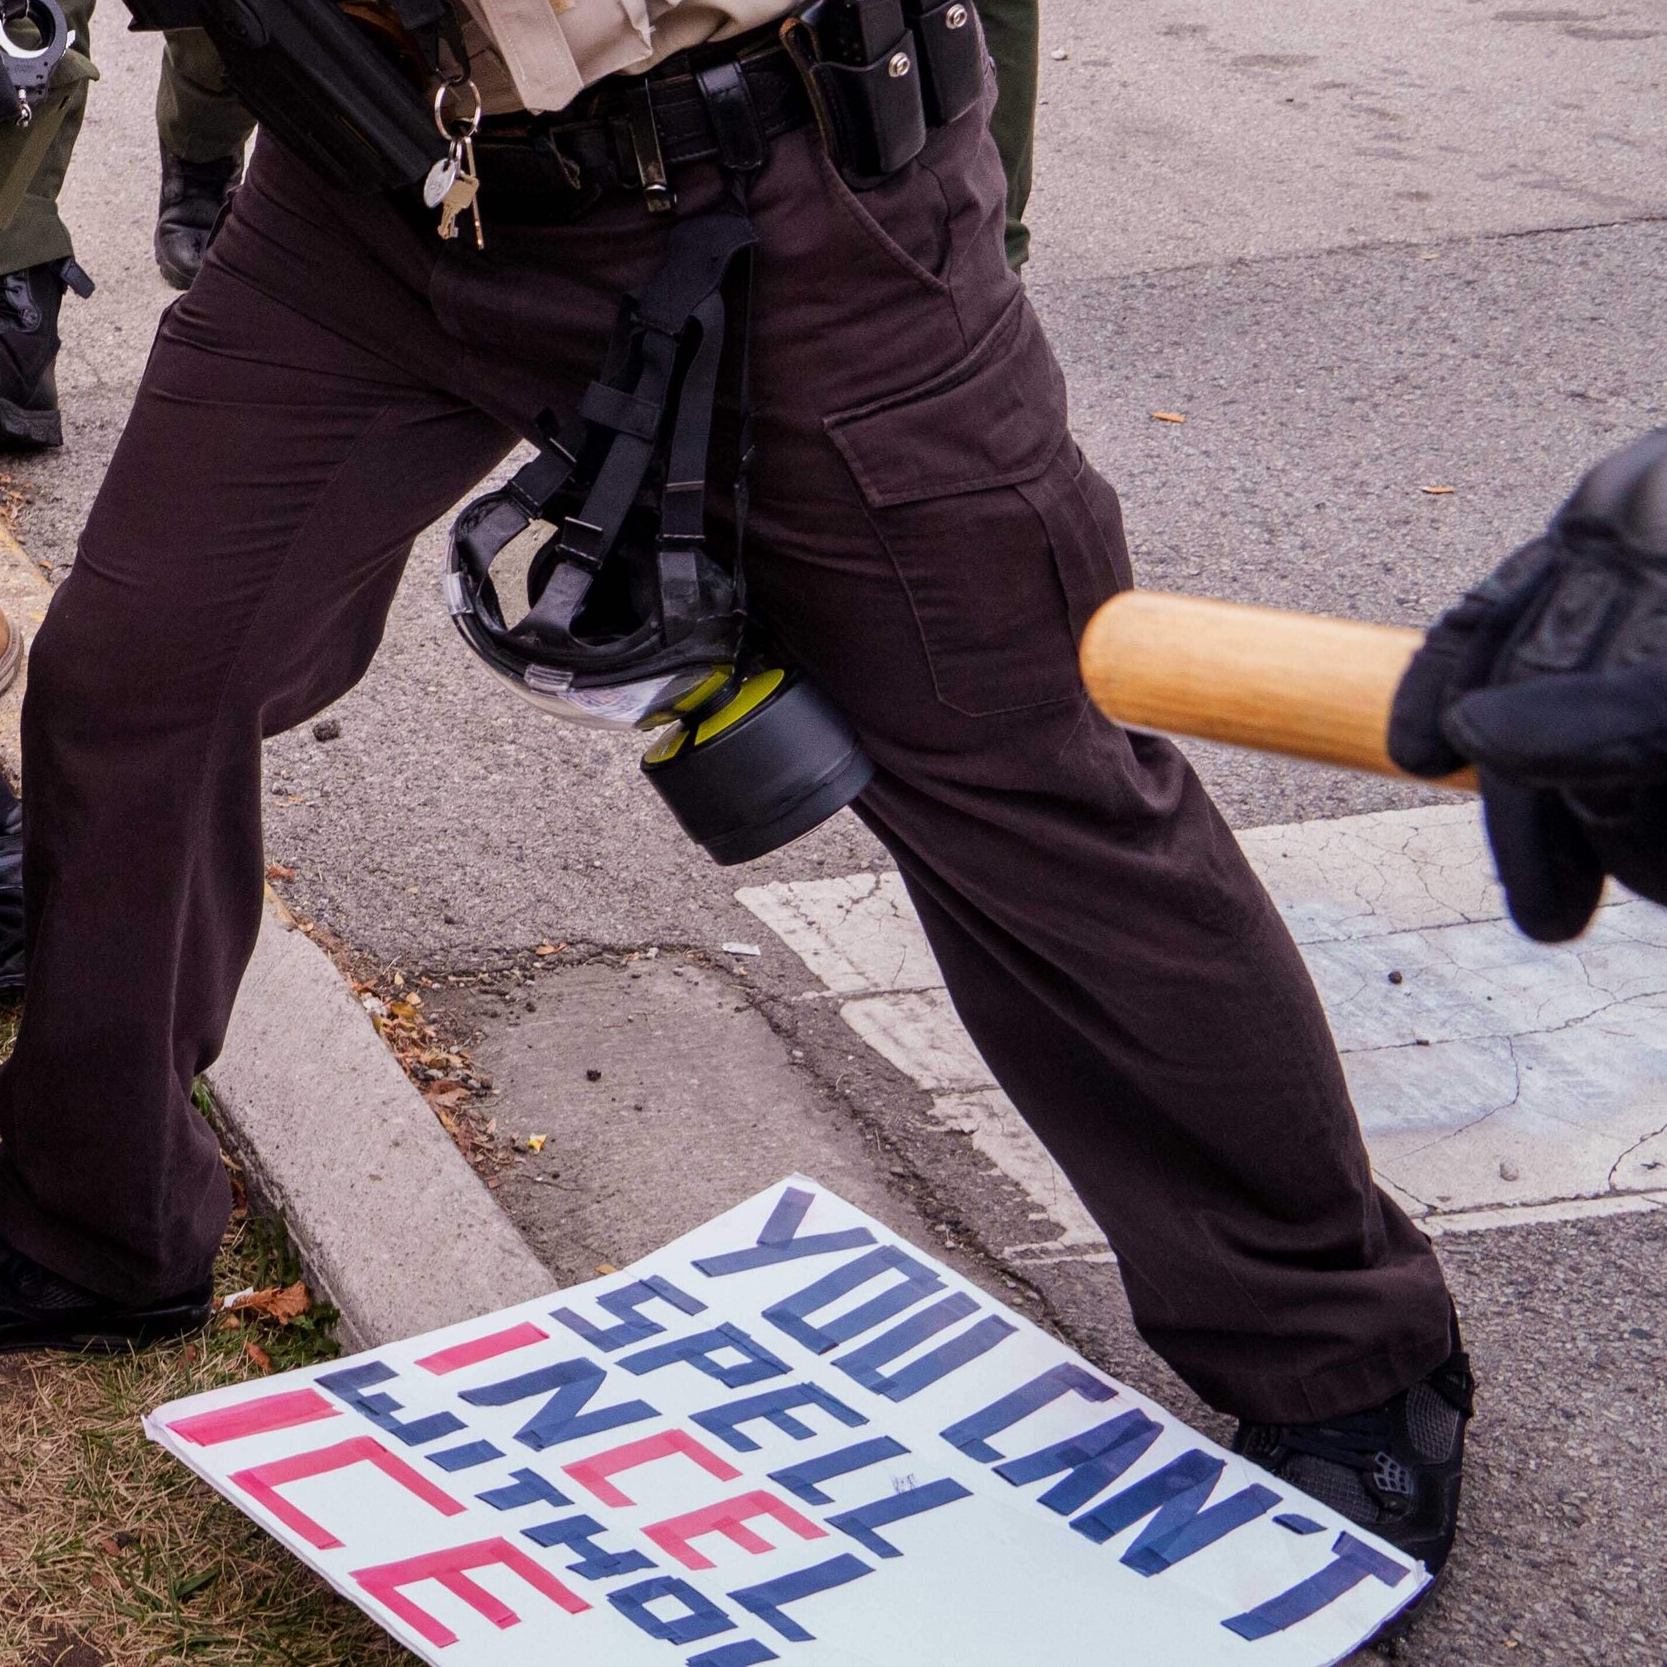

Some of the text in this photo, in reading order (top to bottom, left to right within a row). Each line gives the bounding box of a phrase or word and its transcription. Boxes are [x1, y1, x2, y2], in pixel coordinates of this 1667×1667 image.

[166, 1388, 594, 1648] ICE
[314, 1360, 779, 1667] WITHO
[414, 1321, 876, 1642] INCEL
[549, 1275, 973, 1558] SPELL
[691, 1187, 1410, 1641] YOU CAN'T
